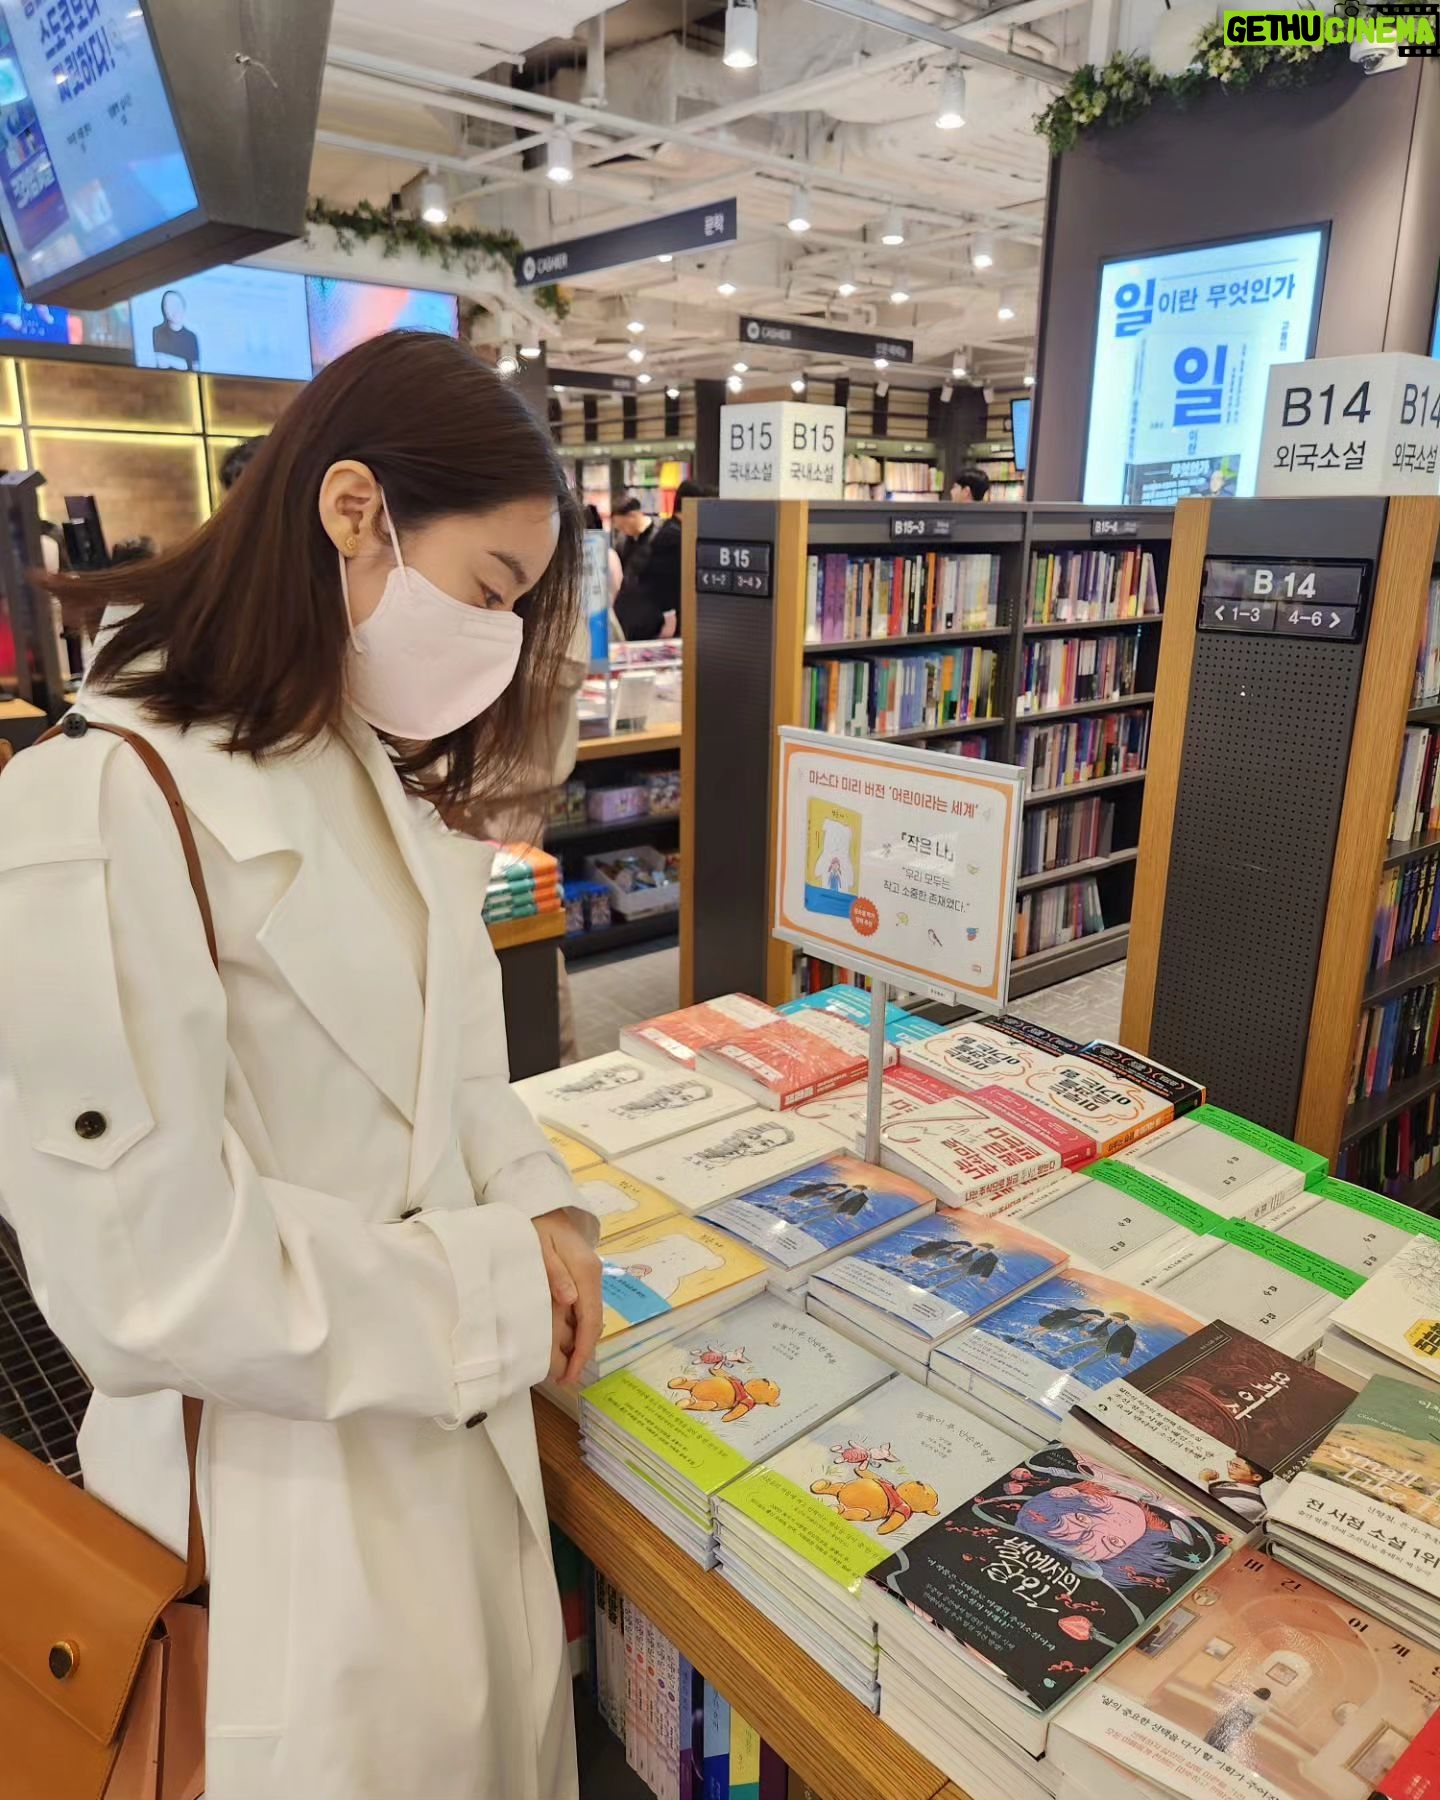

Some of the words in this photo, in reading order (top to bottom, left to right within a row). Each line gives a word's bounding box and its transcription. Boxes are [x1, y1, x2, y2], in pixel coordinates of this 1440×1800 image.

[1206, 273, 1296, 308] 무엇인가
[1173, 344, 1228, 427] 일
[1281, 381, 1371, 427] B14
[1400, 383, 1440, 429] B14
[731, 423, 773, 451] B15
[793, 423, 835, 452] B15
[728, 462, 773, 482] 국내소설
[1274, 440, 1367, 472] 외국소설
[1392, 442, 1438, 475] 외국소설
[790, 462, 835, 483] 국내소설
[808, 770, 839, 788] 마스다
[841, 777, 862, 794] 미리
[864, 781, 886, 800] 버전
[883, 880, 900, 894] 작고
[901, 885, 927, 903] 소중한
[924, 872, 951, 890] 모두는
[1306, 1498, 1325, 1512] 전
[1328, 1508, 1365, 1531] 서점
[1367, 1529, 1407, 1551] 소설
[1413, 1547, 1440, 1569] 1위
[992, 1536, 1081, 1596] 별에서의
[1122, 1707, 1149, 1727] 중요한
[1151, 1722, 1180, 1743] 선택을
[1181, 1739, 1201, 1756] 다시
[1215, 1758, 1245, 1781] 기회가
